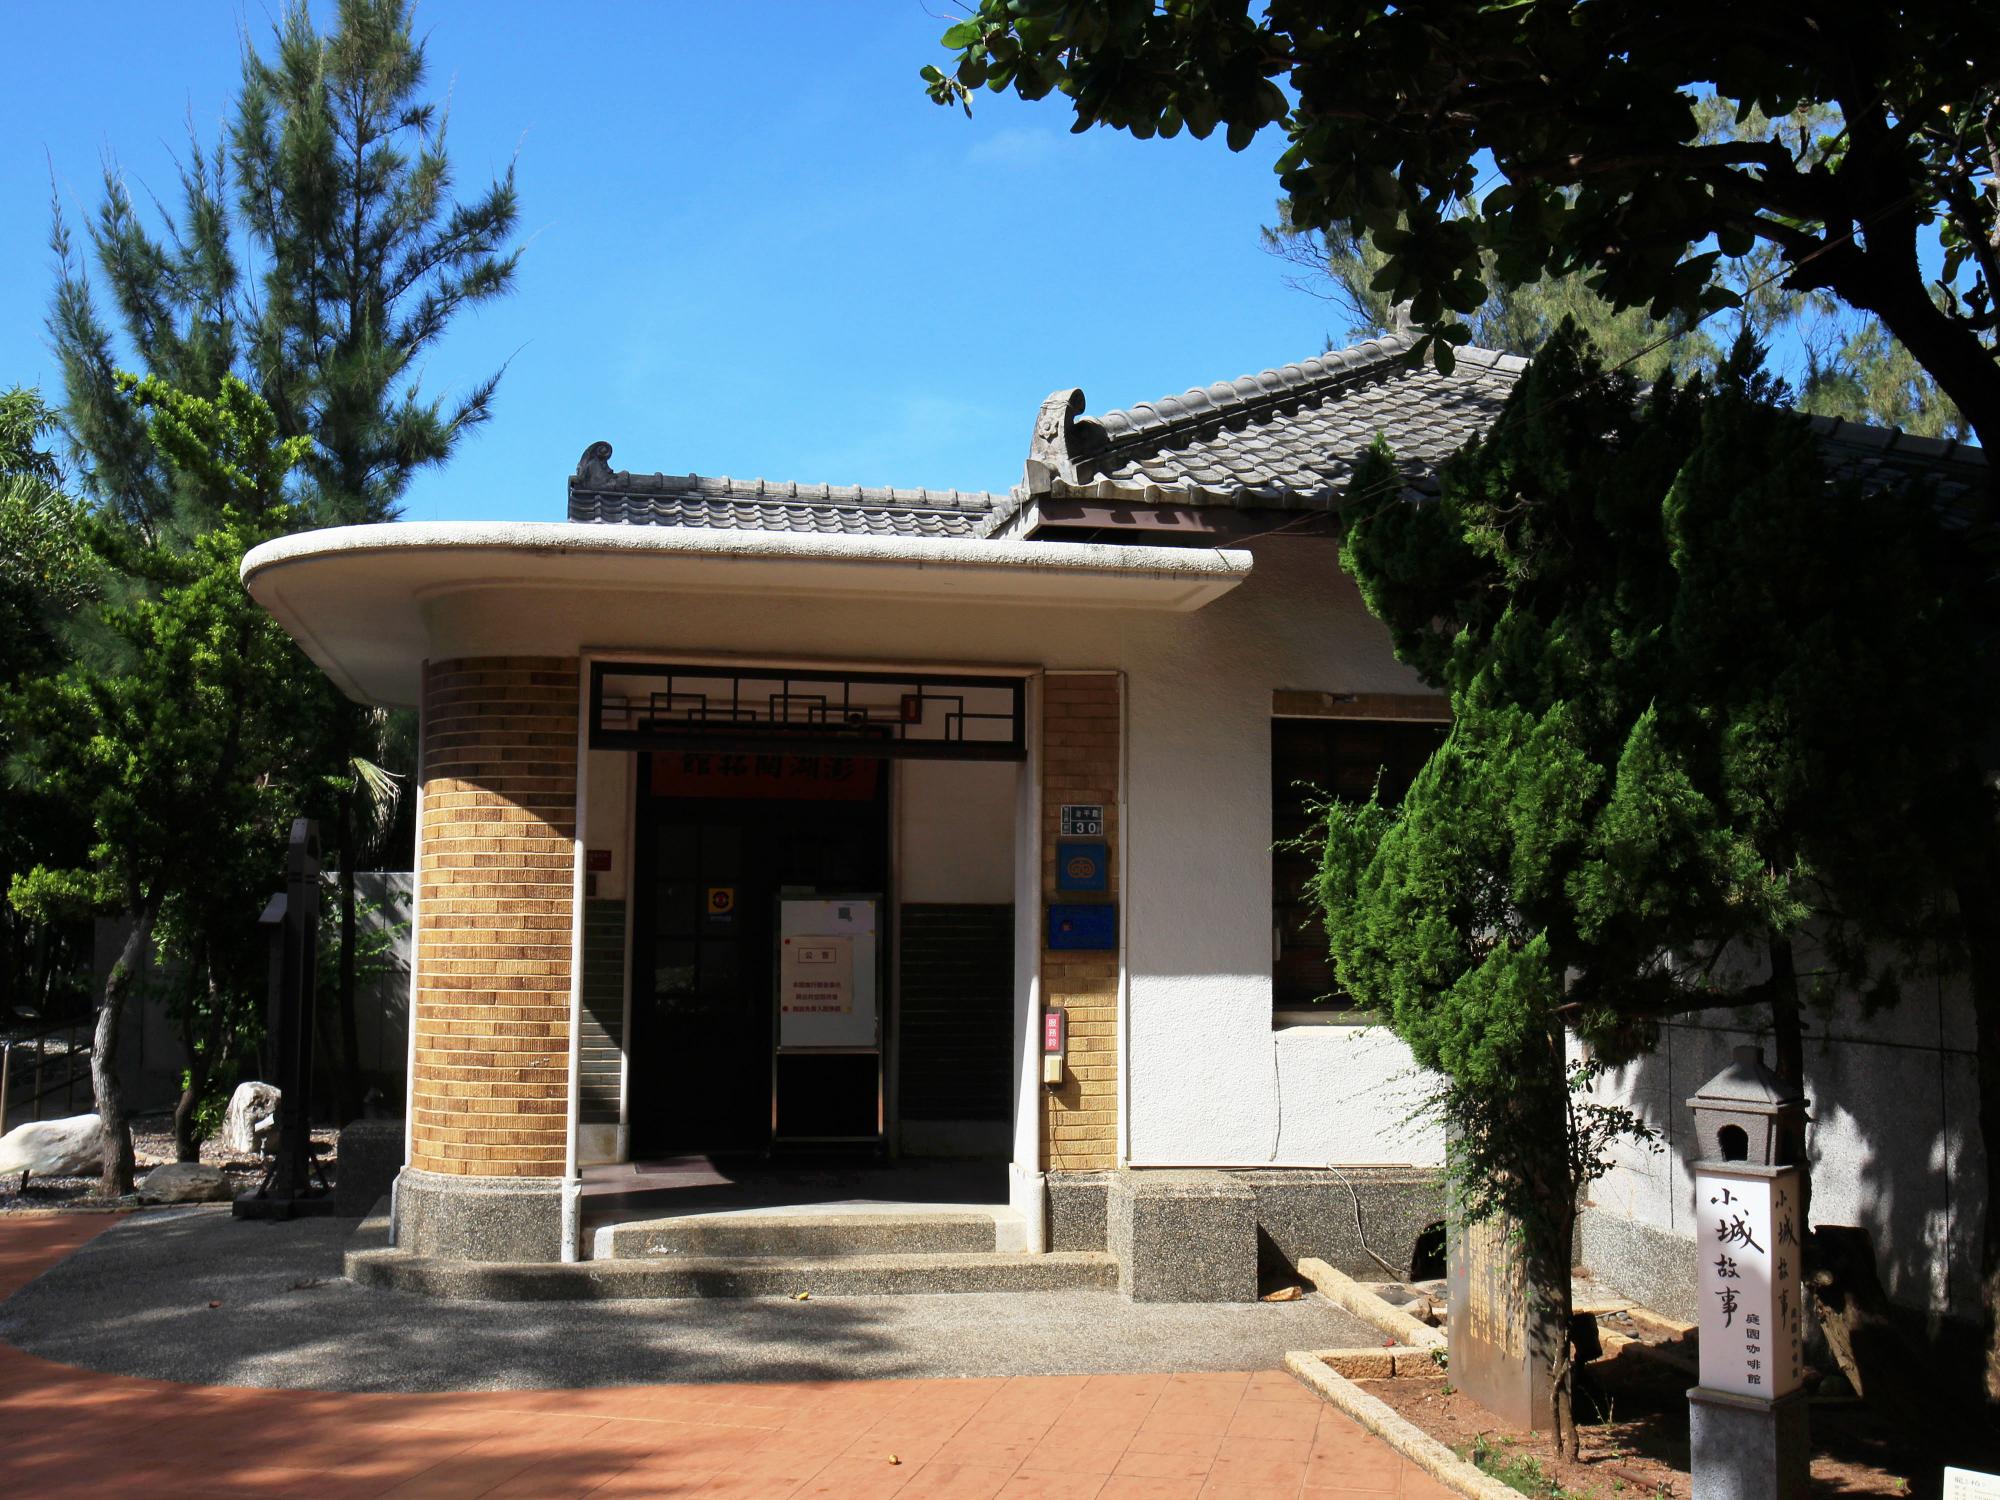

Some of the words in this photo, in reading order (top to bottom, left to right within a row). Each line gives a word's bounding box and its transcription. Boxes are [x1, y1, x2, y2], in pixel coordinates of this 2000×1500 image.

[1076, 822, 1096, 834] 30
[1710, 1187, 1765, 1329] 小城故事
[1775, 1190, 1799, 1332] 小城故事
[1745, 1313, 1761, 1386] 庭園咖啡館
